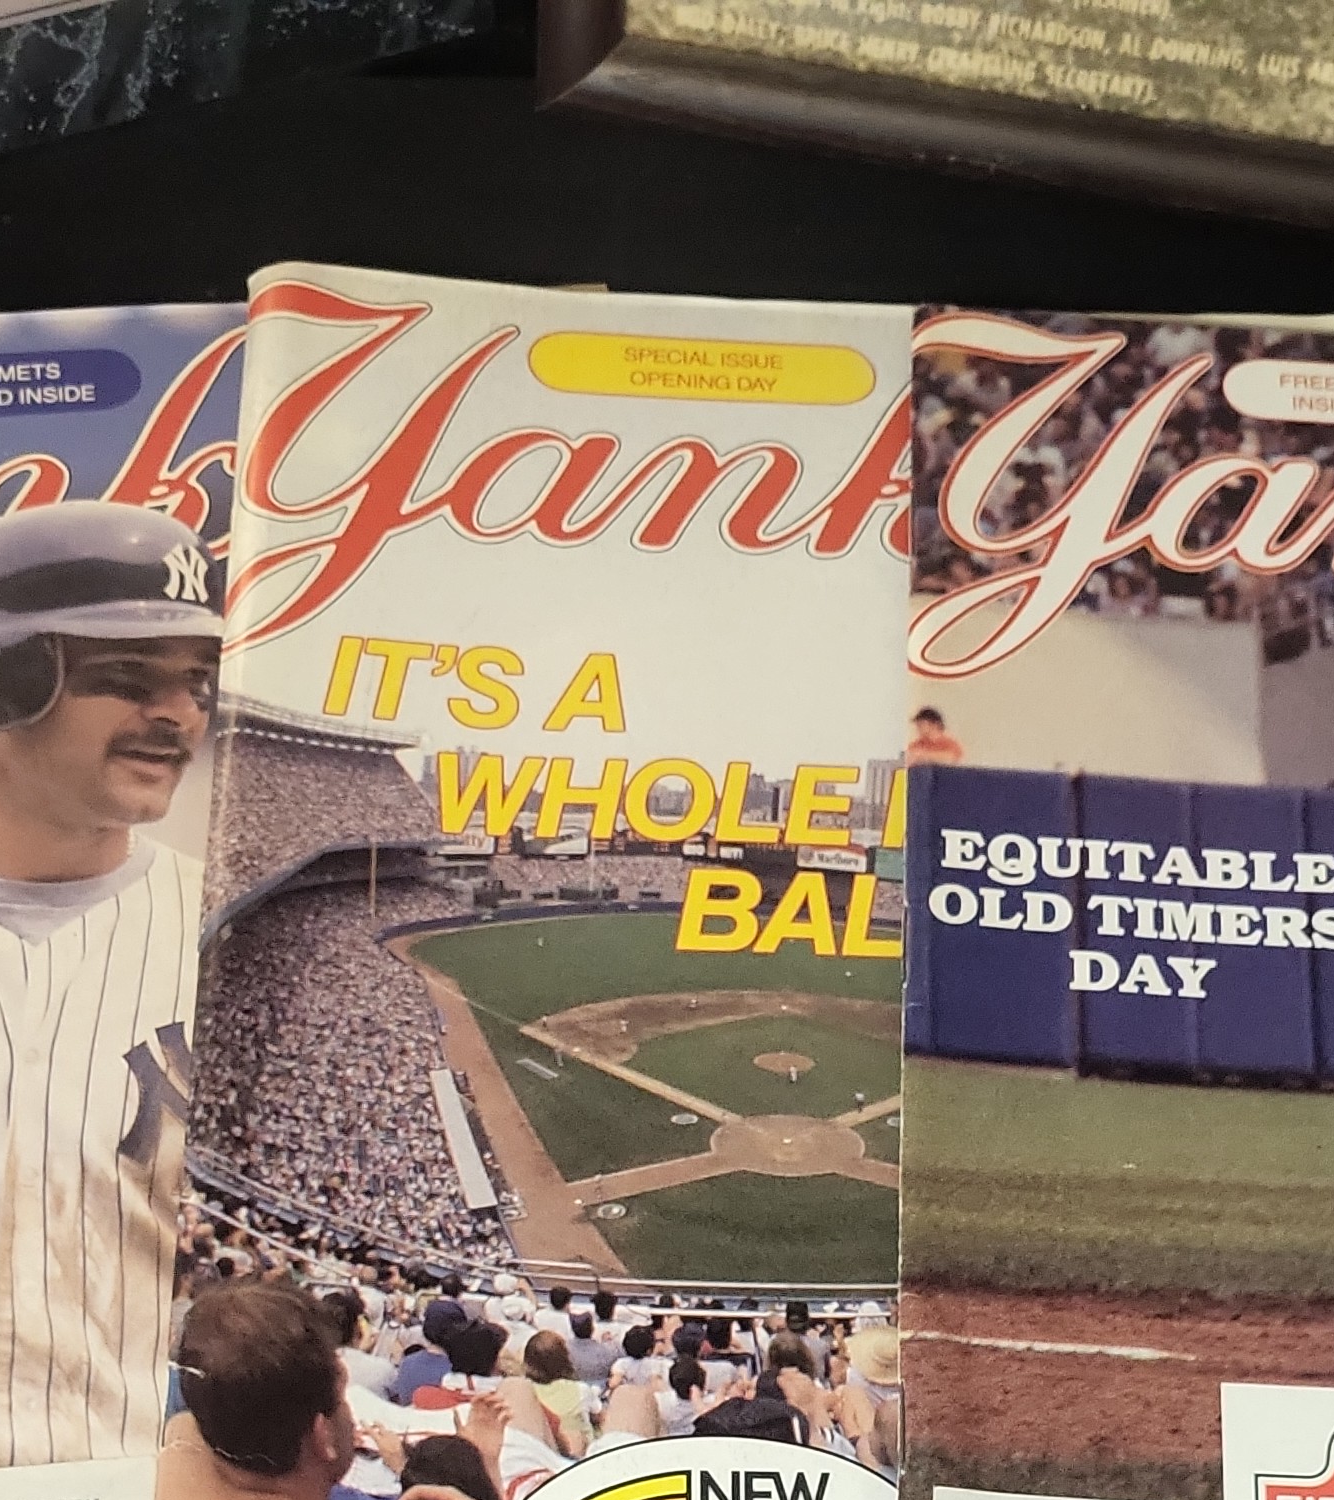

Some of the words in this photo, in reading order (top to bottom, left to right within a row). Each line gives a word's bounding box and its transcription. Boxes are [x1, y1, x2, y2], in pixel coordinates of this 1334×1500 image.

[624, 347, 714, 366] SPECIAL
[721, 352, 783, 369] ISSUE
[630, 371, 730, 390] OPENING
[737, 377, 778, 392] DAY
[17, 385, 96, 408] INSIDE
[323, 636, 524, 730] IT'S
[543, 653, 626, 732] A
[436, 750, 859, 848] WHOLE
[928, 884, 1072, 933] OLD
[1068, 950, 1217, 999] DAY
